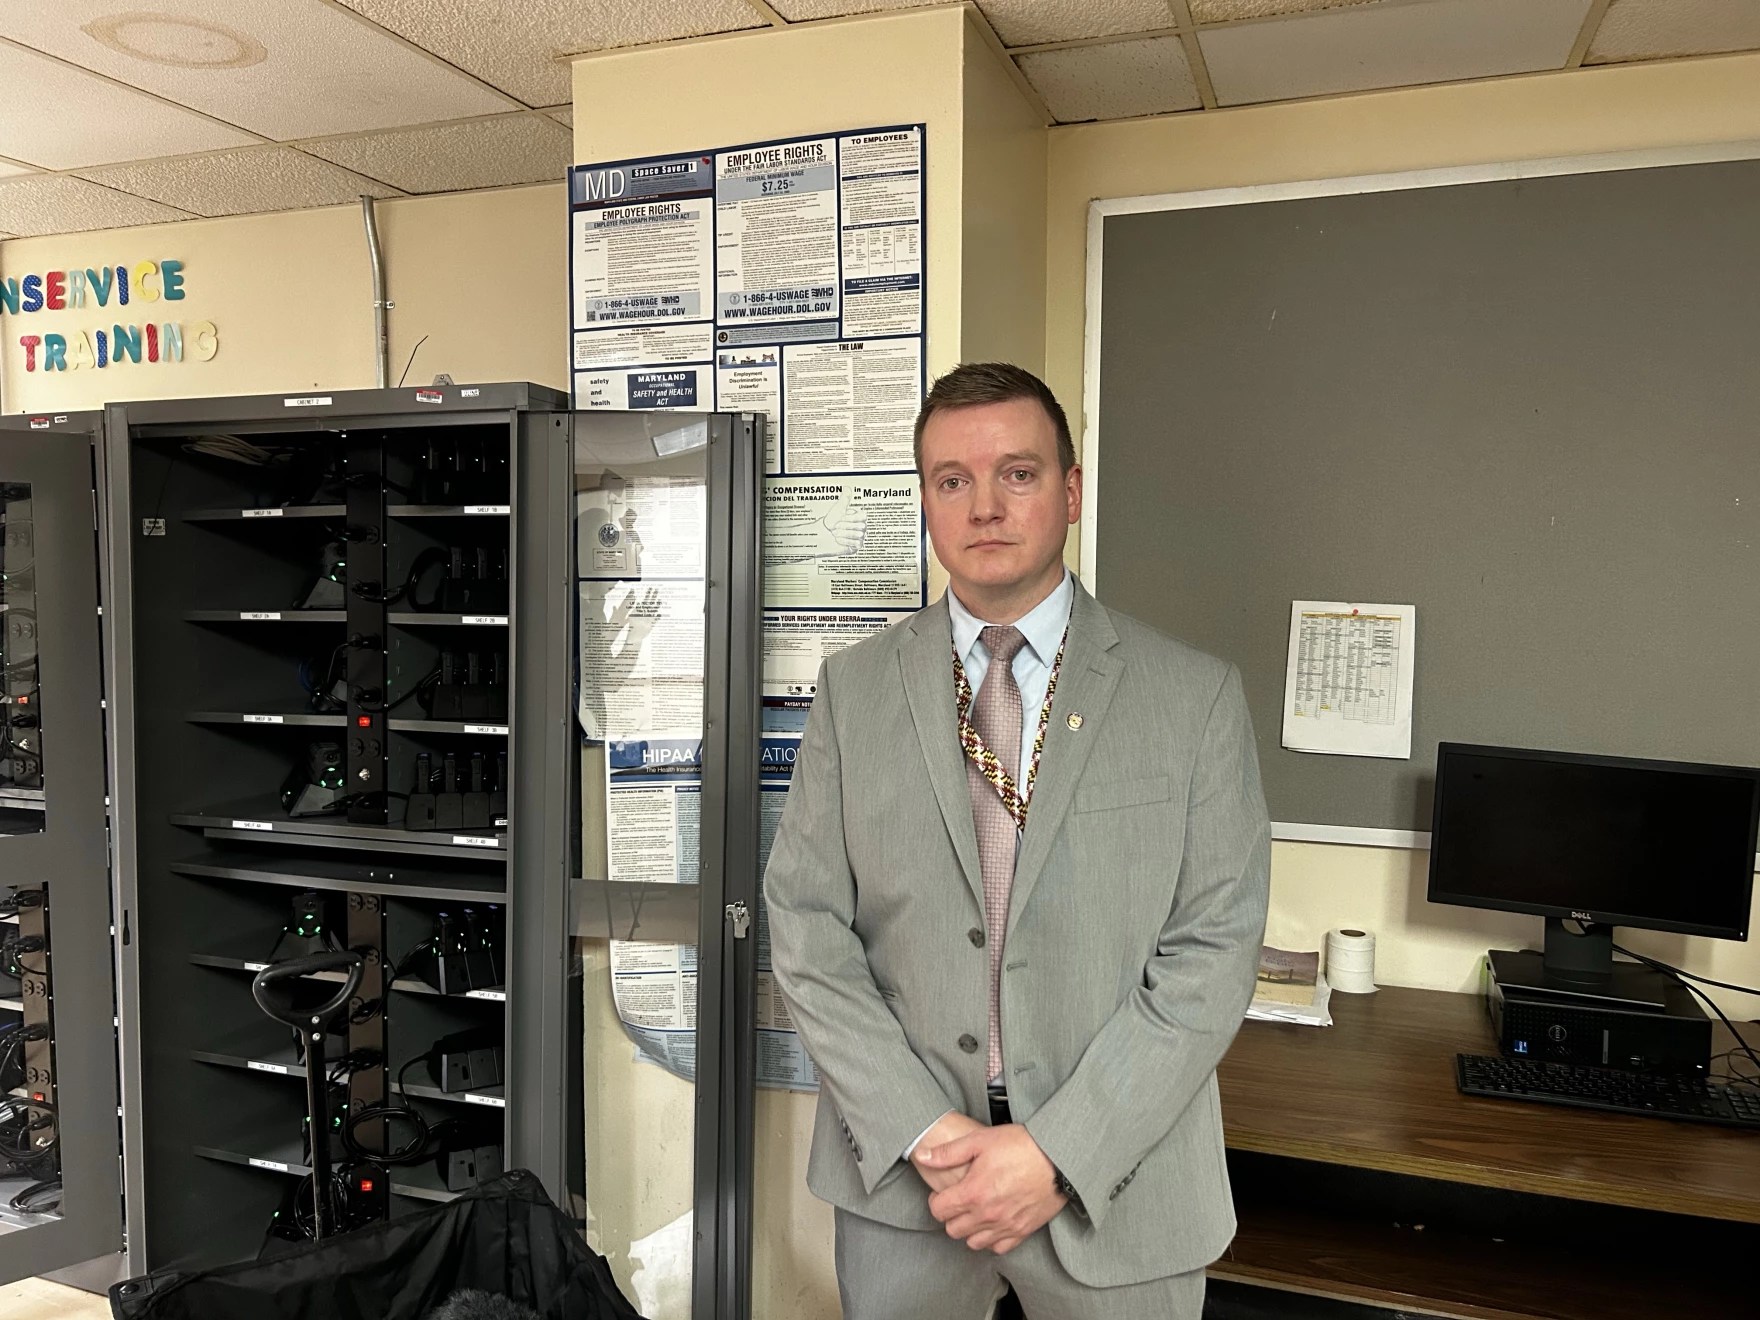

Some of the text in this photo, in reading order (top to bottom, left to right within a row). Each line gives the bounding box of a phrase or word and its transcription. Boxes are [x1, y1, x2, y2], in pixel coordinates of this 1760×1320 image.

[864, 134, 908, 144] EMPLOYEES
[727, 144, 823, 167] EMPLOYEE RIGHTS
[784, 156, 816, 166] STANDARDS
[634, 168, 658, 178] Space
[662, 164, 686, 174] Saver
[746, 174, 766, 182] FEDERAL
[768, 172, 790, 180] MINIMUM
[586, 169, 626, 200] MD
[762, 180, 789, 192] $7.25
[602, 203, 681, 220] EMPLOYEE RIGHTS
[594, 220, 618, 229] EMPLOYEE
[620, 216, 648, 227] POLYGRAPH
[648, 214, 680, 224] PROTECTION
[743, 290, 810, 303] 1-866-4-USWAGE
[604, 298, 658, 308] 1-866-4-USWAGE
[600, 308, 686, 320] WWW.WAGEHOUR.DOL.GOV
[724, 302, 831, 318] WWW.WAGEHOUR.DOL.GOV
[20, 320, 218, 372] TRAINING
[638, 374, 686, 383] MARYLAND
[633, 389, 656, 398] SAFETY
[668, 388, 693, 396] HEALTH
[773, 486, 842, 494] COMPENSATION
[863, 488, 911, 498] Maryland
[642, 748, 695, 762] HIPAA
[762, 748, 800, 762] ATIO
[1571, 911, 1591, 920] DELL
